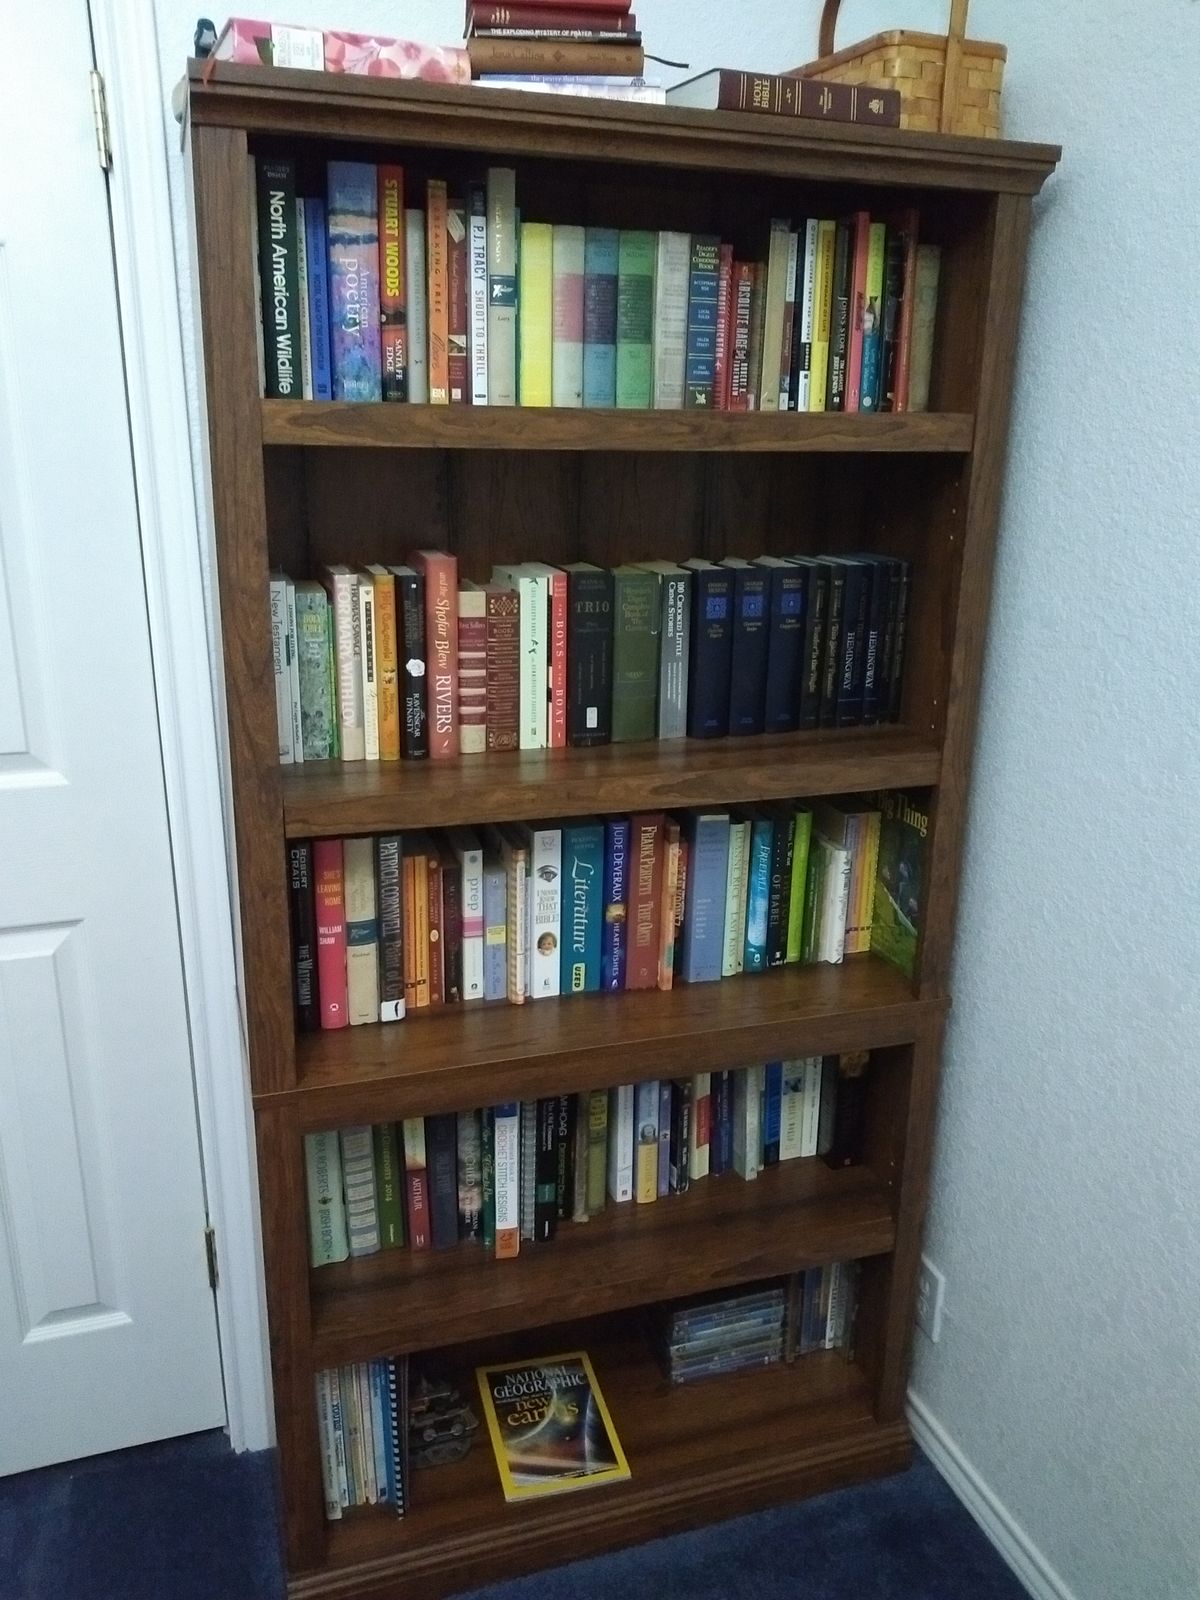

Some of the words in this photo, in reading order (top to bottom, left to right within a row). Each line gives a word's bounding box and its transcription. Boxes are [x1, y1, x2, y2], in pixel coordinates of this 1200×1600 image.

[570, 29, 592, 37] PRAYER
[753, 79, 763, 106] HOLY
[761, 79, 770, 108] BIBLE
[270, 191, 287, 238] North
[385, 179, 399, 236] STUART
[474, 225, 484, 234] P.
[474, 235, 484, 243] J.
[386, 242, 399, 296] WOODS
[474, 246, 485, 281] TRACY
[273, 244, 290, 330] American
[340, 257, 362, 336] poetry
[359, 267, 369, 328] American
[475, 290, 485, 321] SHOOT
[736, 280, 750, 325] ABSOLUTE
[476, 326, 485, 338] TO
[735, 328, 749, 349] RAGE
[276, 334, 294, 394] Wildlife
[386, 347, 394, 372] EDGE
[394, 339, 403, 366] SANTA
[476, 343, 485, 377] THRILL
[395, 368, 403, 380] FE
[271, 591, 282, 618] New
[337, 583, 350, 617] FOR
[351, 583, 359, 623] THOMAS
[439, 586, 447, 597] the
[575, 600, 610, 613] TRIO
[435, 599, 450, 637] Shofar
[667, 607, 675, 637] STORIES
[676, 594, 684, 631] CROOKED
[273, 621, 285, 675] Testament
[338, 617, 352, 660] MARY,
[434, 640, 450, 669] Blew
[843, 632, 855, 689] HEMINGWAY
[865, 631, 877, 688] HEMINGWAY
[340, 661, 352, 700] WITH
[342, 702, 354, 728] LOV
[436, 675, 451, 733] RIVERS
[613, 826, 624, 850] JUDE
[641, 825, 657, 855] FRANK
[291, 850, 300, 888] CRAIS
[380, 842, 398, 886] PATRICIA
[612, 852, 623, 901] DEVERAUX
[639, 858, 655, 895] PERETTI
[758, 845, 770, 893] FREEFALL
[317, 884, 341, 893] LEAVING
[468, 878, 481, 911] prep
[732, 877, 742, 900] RICE
[772, 874, 781, 888] OF
[325, 897, 341, 906] HOME
[382, 887, 401, 937] CORNWELL
[537, 903, 557, 912] THAT
[572, 856, 594, 952] Literature
[638, 901, 653, 922] THE
[770, 895, 779, 927] BABEL
[319, 925, 342, 934] WILLIAM
[730, 911, 738, 934] LAST
[298, 945, 309, 959] THE
[319, 937, 335, 945] SHAW
[612, 922, 620, 976] HEARTWISHES
[729, 937, 738, 957] KISS
[297, 959, 312, 1005] WATCHMAN
[559, 1108, 567, 1136] HOAG
[497, 1125, 508, 1161] CROCHET
[314, 1156, 330, 1194] ROBERTS
[497, 1162, 508, 1188] STITCH
[413, 1177, 422, 1210] ARTHUR
[497, 1190, 508, 1223] DESIGNS
[319, 1209, 330, 1228] IRISH
[321, 1229, 334, 1253] BORN
[494, 1373, 587, 1399] GEOGRAPHIC
[505, 1366, 568, 1385] NATIONAL
[516, 1397, 550, 1411] new
